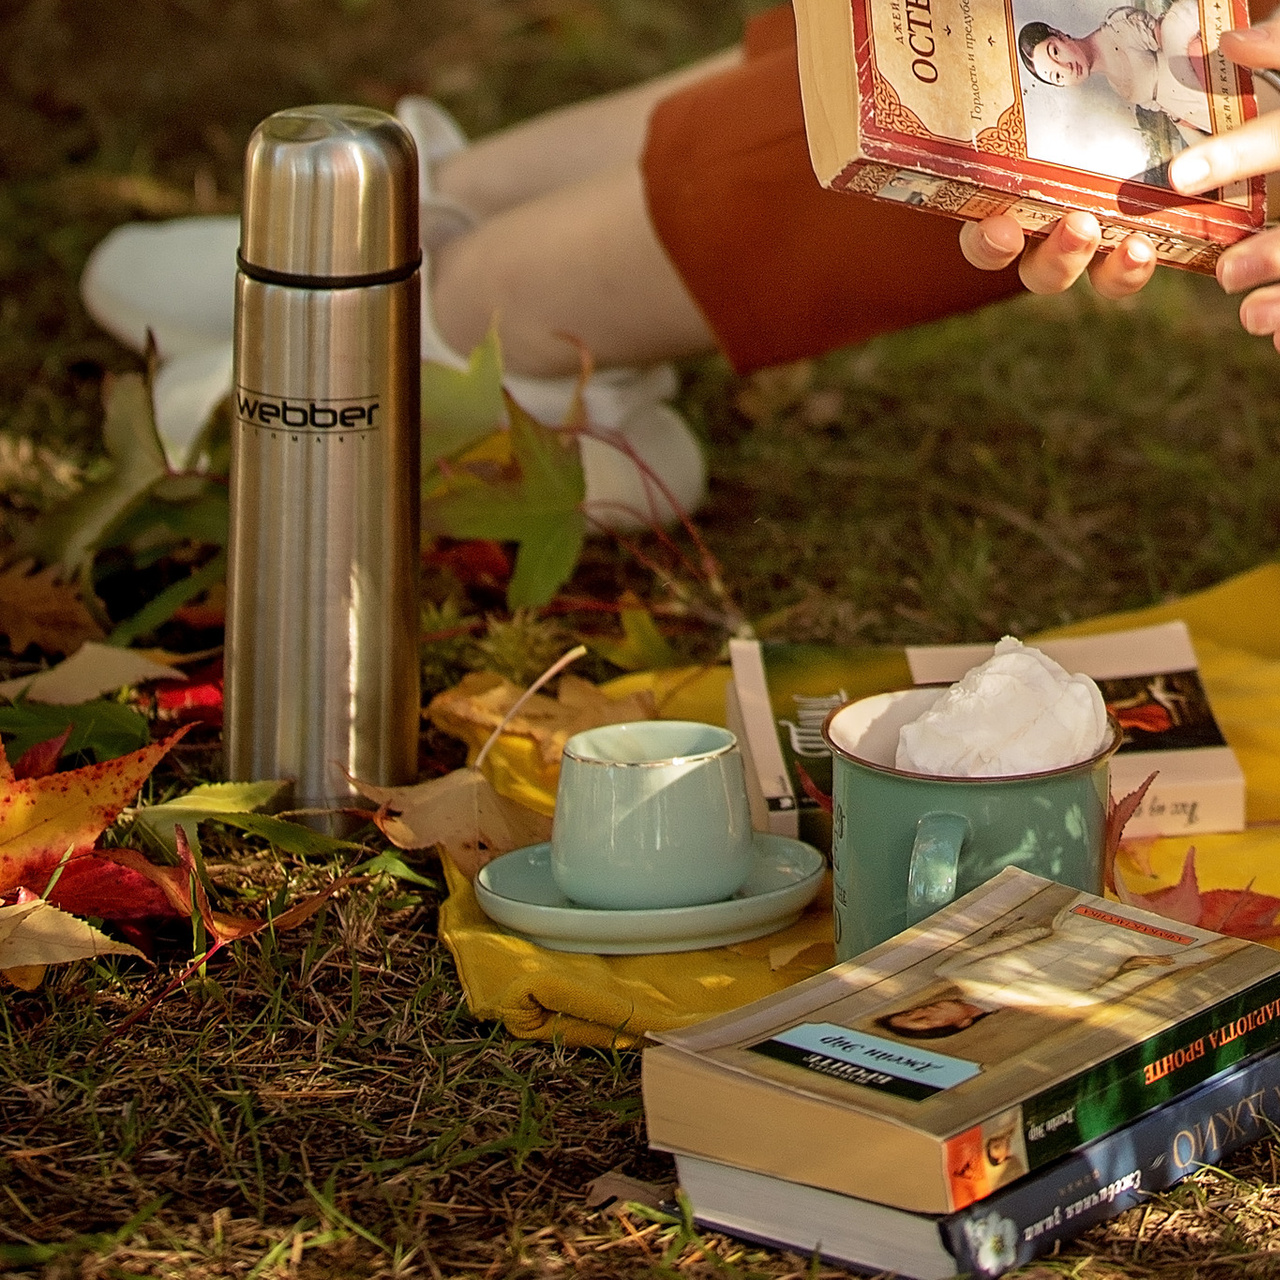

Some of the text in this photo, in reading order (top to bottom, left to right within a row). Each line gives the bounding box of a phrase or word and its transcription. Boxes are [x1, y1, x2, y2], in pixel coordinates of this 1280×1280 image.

[1213, 15, 1228, 83] КЛАСИКА
[966, 64, 984, 122] Гордость
[237, 392, 380, 429] webber
[818, 1034, 864, 1056] Эйр
[1142, 1037, 1206, 1086] БРОНТЕ
[1171, 1087, 1267, 1171] ДЖИО
[1022, 1168, 1143, 1244] Ежевичная зима
